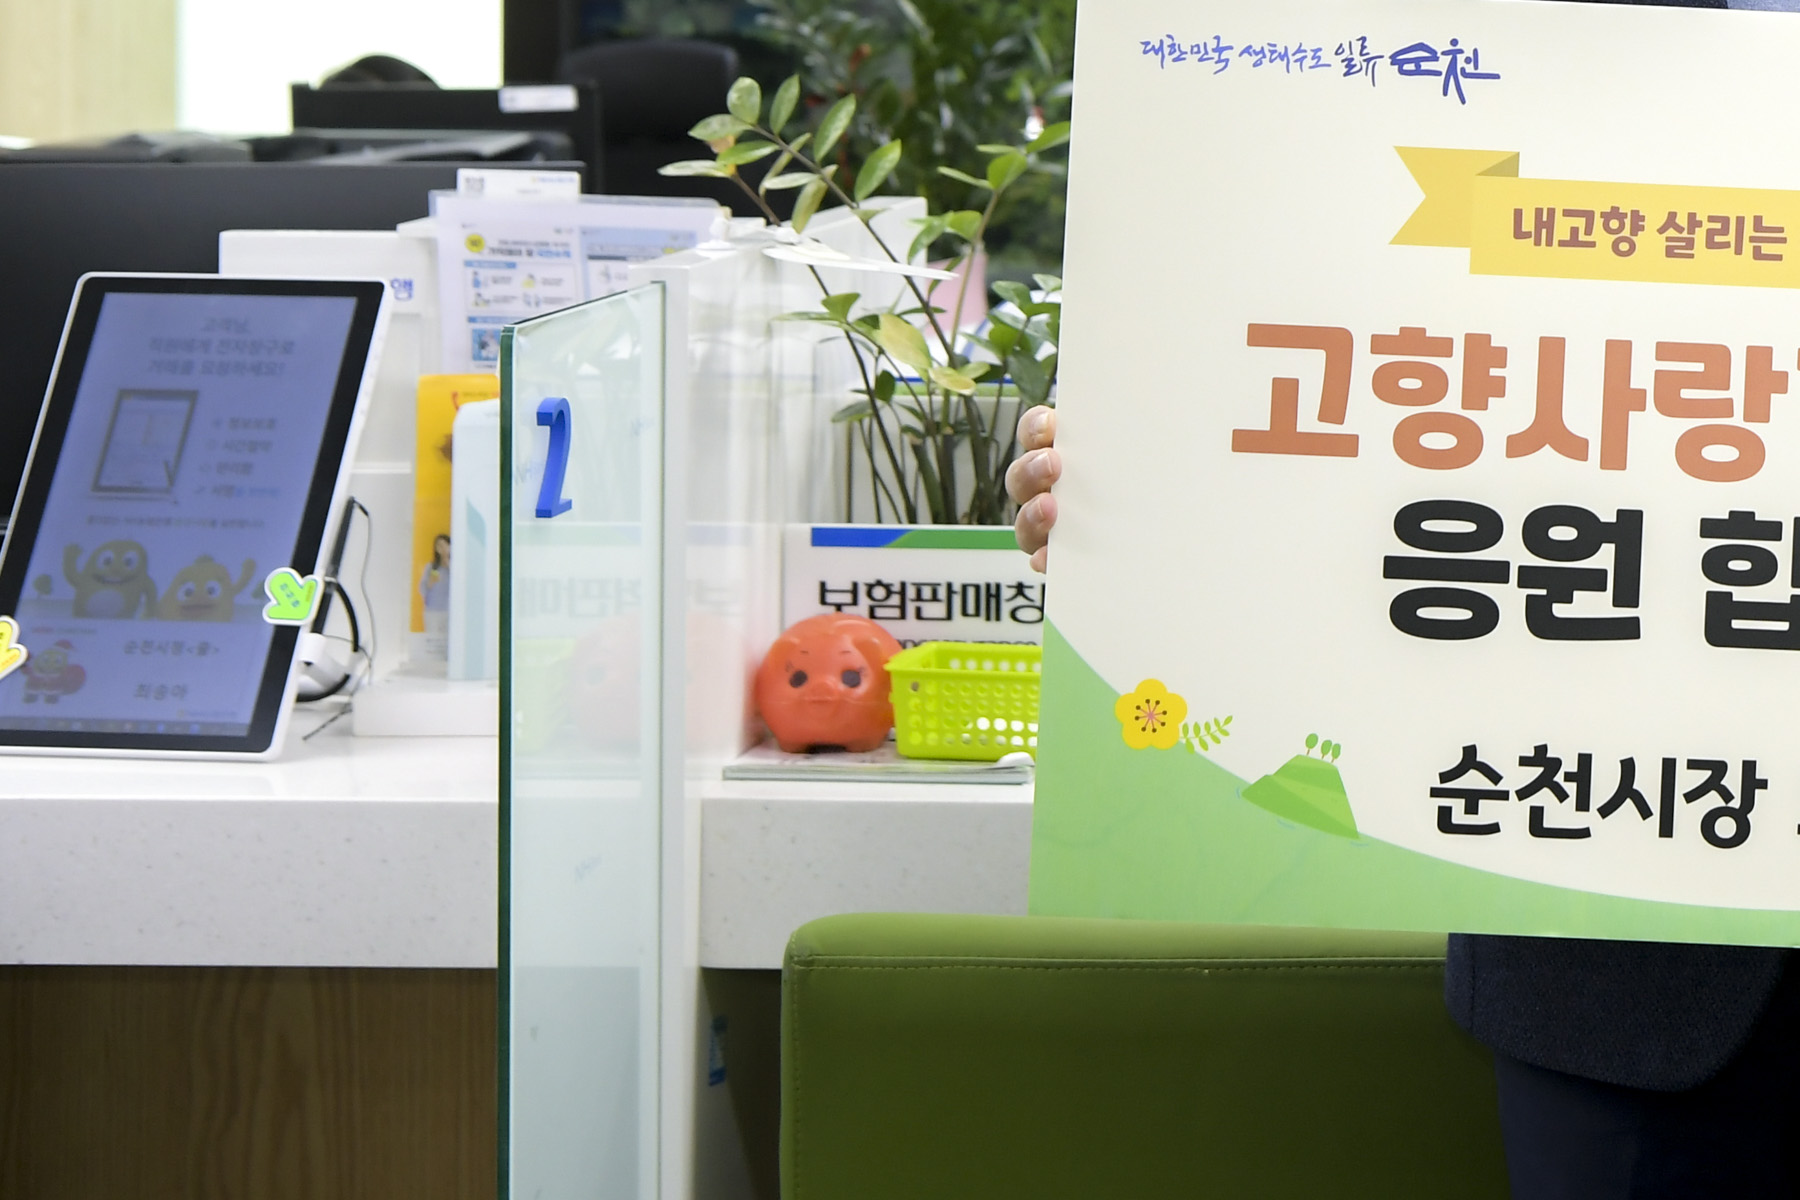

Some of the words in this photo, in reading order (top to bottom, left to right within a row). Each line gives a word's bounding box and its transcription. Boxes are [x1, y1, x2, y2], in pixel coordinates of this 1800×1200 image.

[1140, 34, 1234, 74] 대한민국
[1239, 41, 1332, 74] 생태수도
[1334, 36, 1385, 87] 일류
[1389, 38, 1501, 105] 순천
[1513, 206, 1645, 258] 내고향
[1657, 212, 1788, 261] 살리는
[535, 397, 572, 518] 2
[1383, 500, 1643, 641] 응원
[1429, 744, 1768, 849] 순천시장
